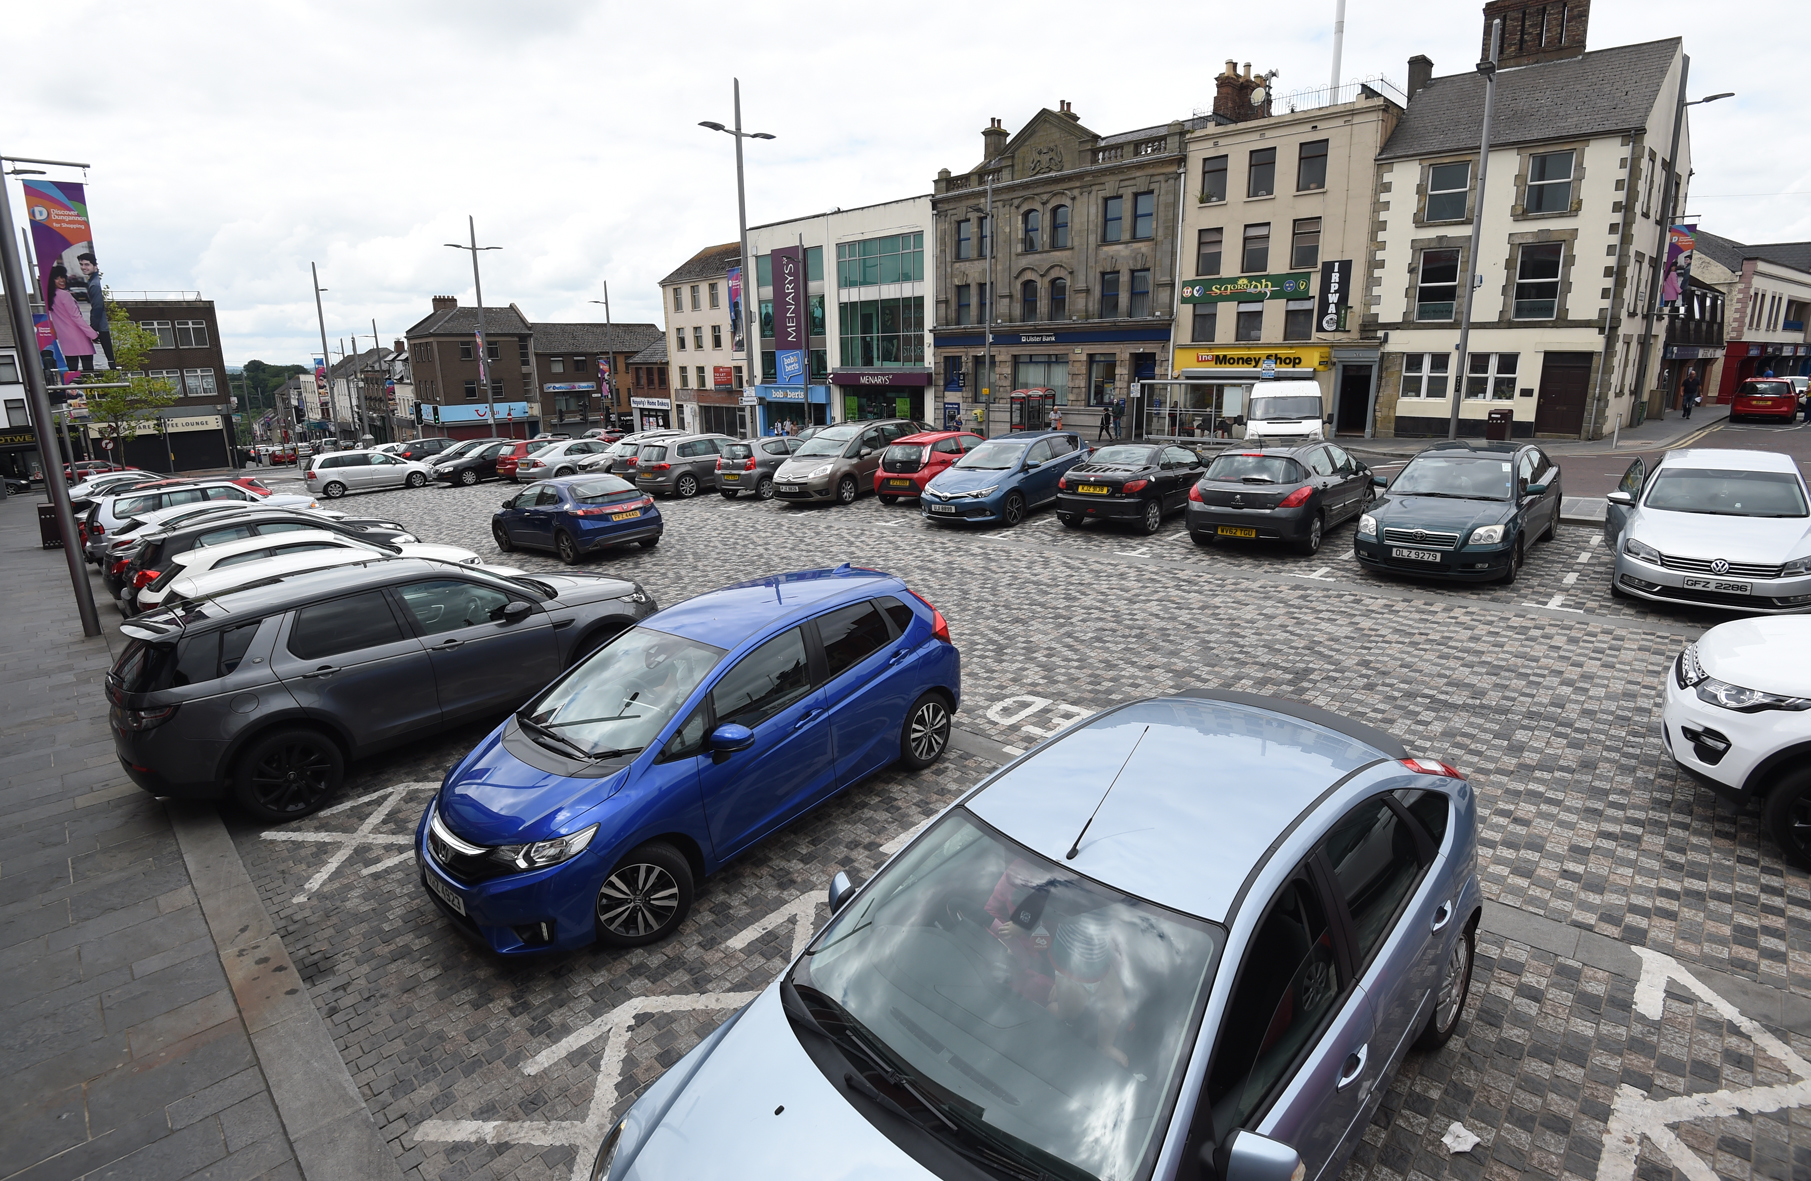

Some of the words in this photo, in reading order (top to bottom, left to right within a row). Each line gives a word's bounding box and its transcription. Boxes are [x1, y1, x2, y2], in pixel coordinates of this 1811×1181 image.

[52, 214, 87, 222] Dungannon
[1327, 262, 1340, 313] IRPWA
[783, 263, 797, 341] MENARYS
[1042, 334, 1056, 342] Bank
[1214, 355, 1262, 368] Money
[859, 375, 890, 385] MENARYS
[181, 420, 209, 428] LOUNGE
[1220, 526, 1238, 535] WV62
[1239, 529, 1253, 537] TGU
[1395, 548, 1413, 558] OLZ
[1414, 551, 1438, 561] 9279
[1686, 579, 1711, 589] GFZ
[1714, 582, 1748, 592] 2286
[441, 885, 462, 911] 4923
